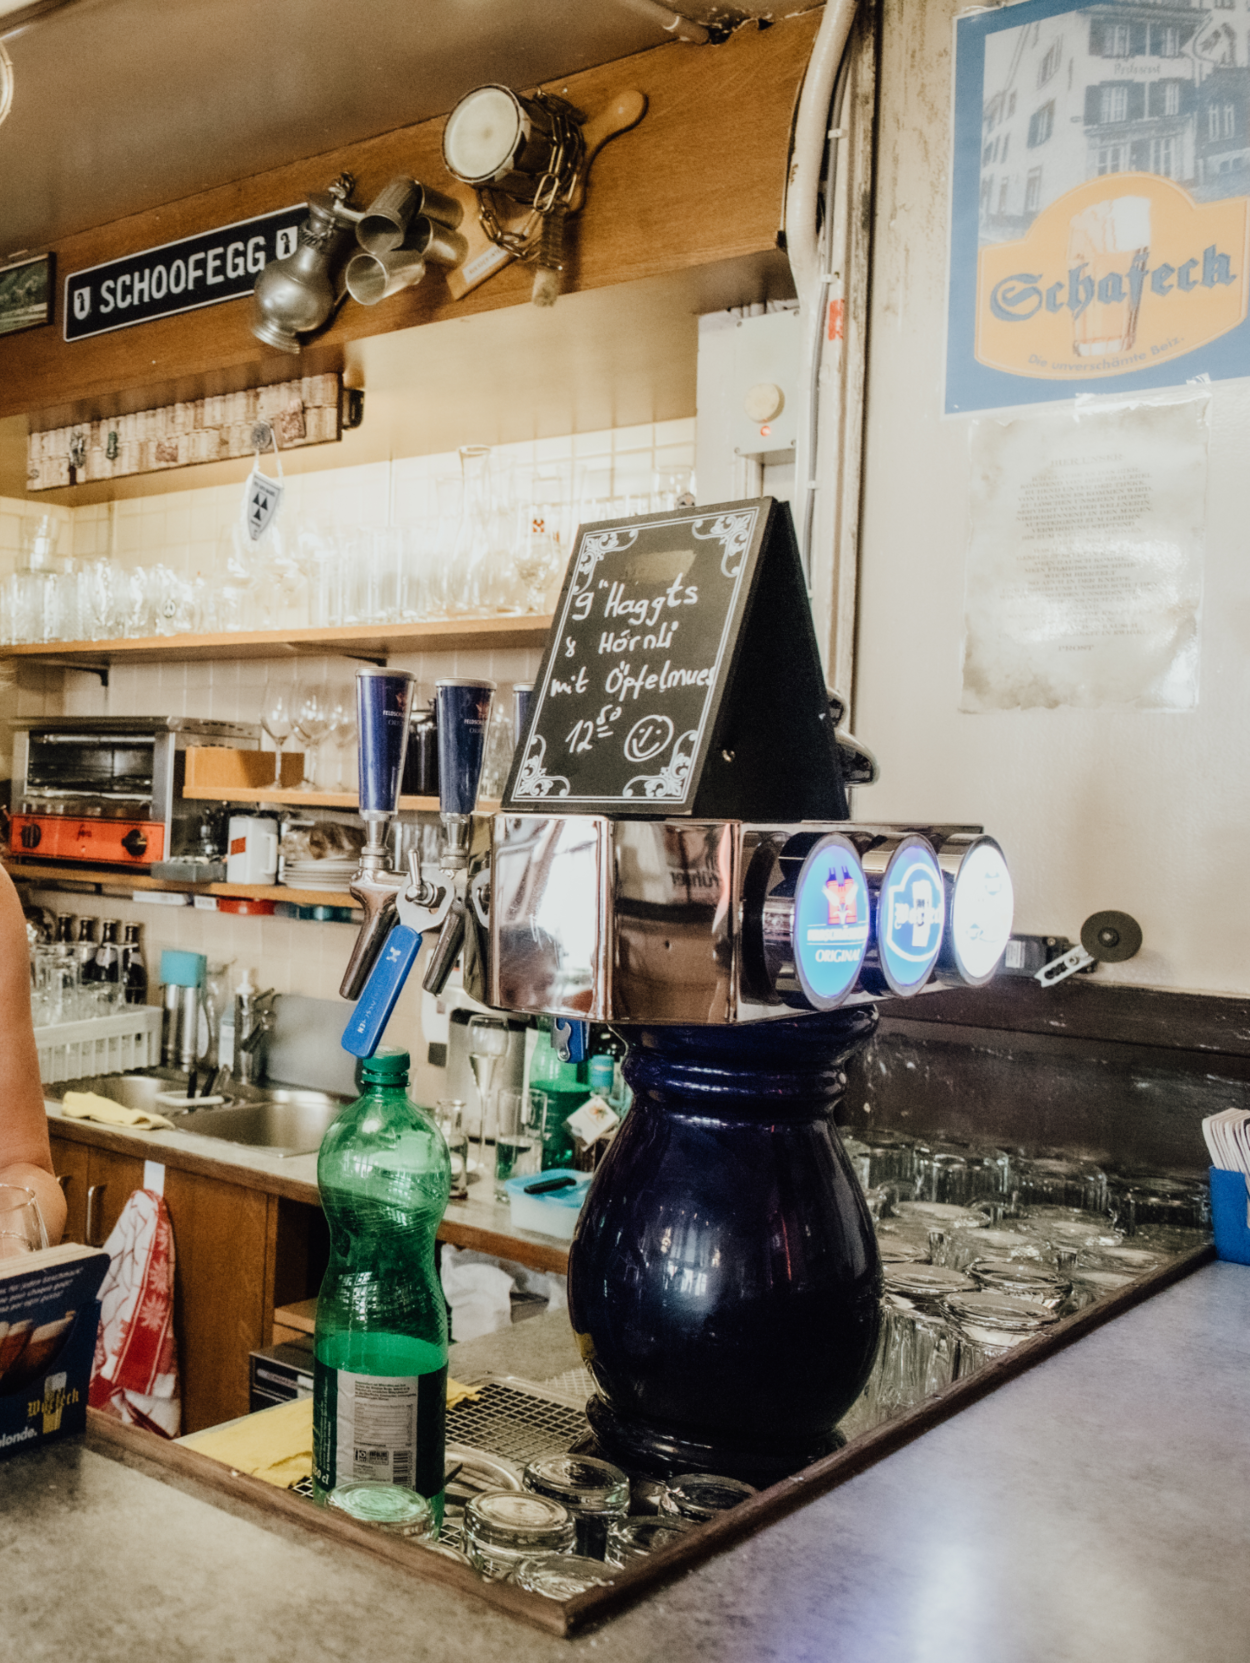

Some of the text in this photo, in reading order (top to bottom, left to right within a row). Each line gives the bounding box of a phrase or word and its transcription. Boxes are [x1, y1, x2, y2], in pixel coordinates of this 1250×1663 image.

[100, 235, 267, 313] SCHOOFEGG
[989, 243, 1238, 322] Schafeck
[1028, 335, 1185, 371] Die unverschämte Beiz.
[550, 666, 590, 697] mit
